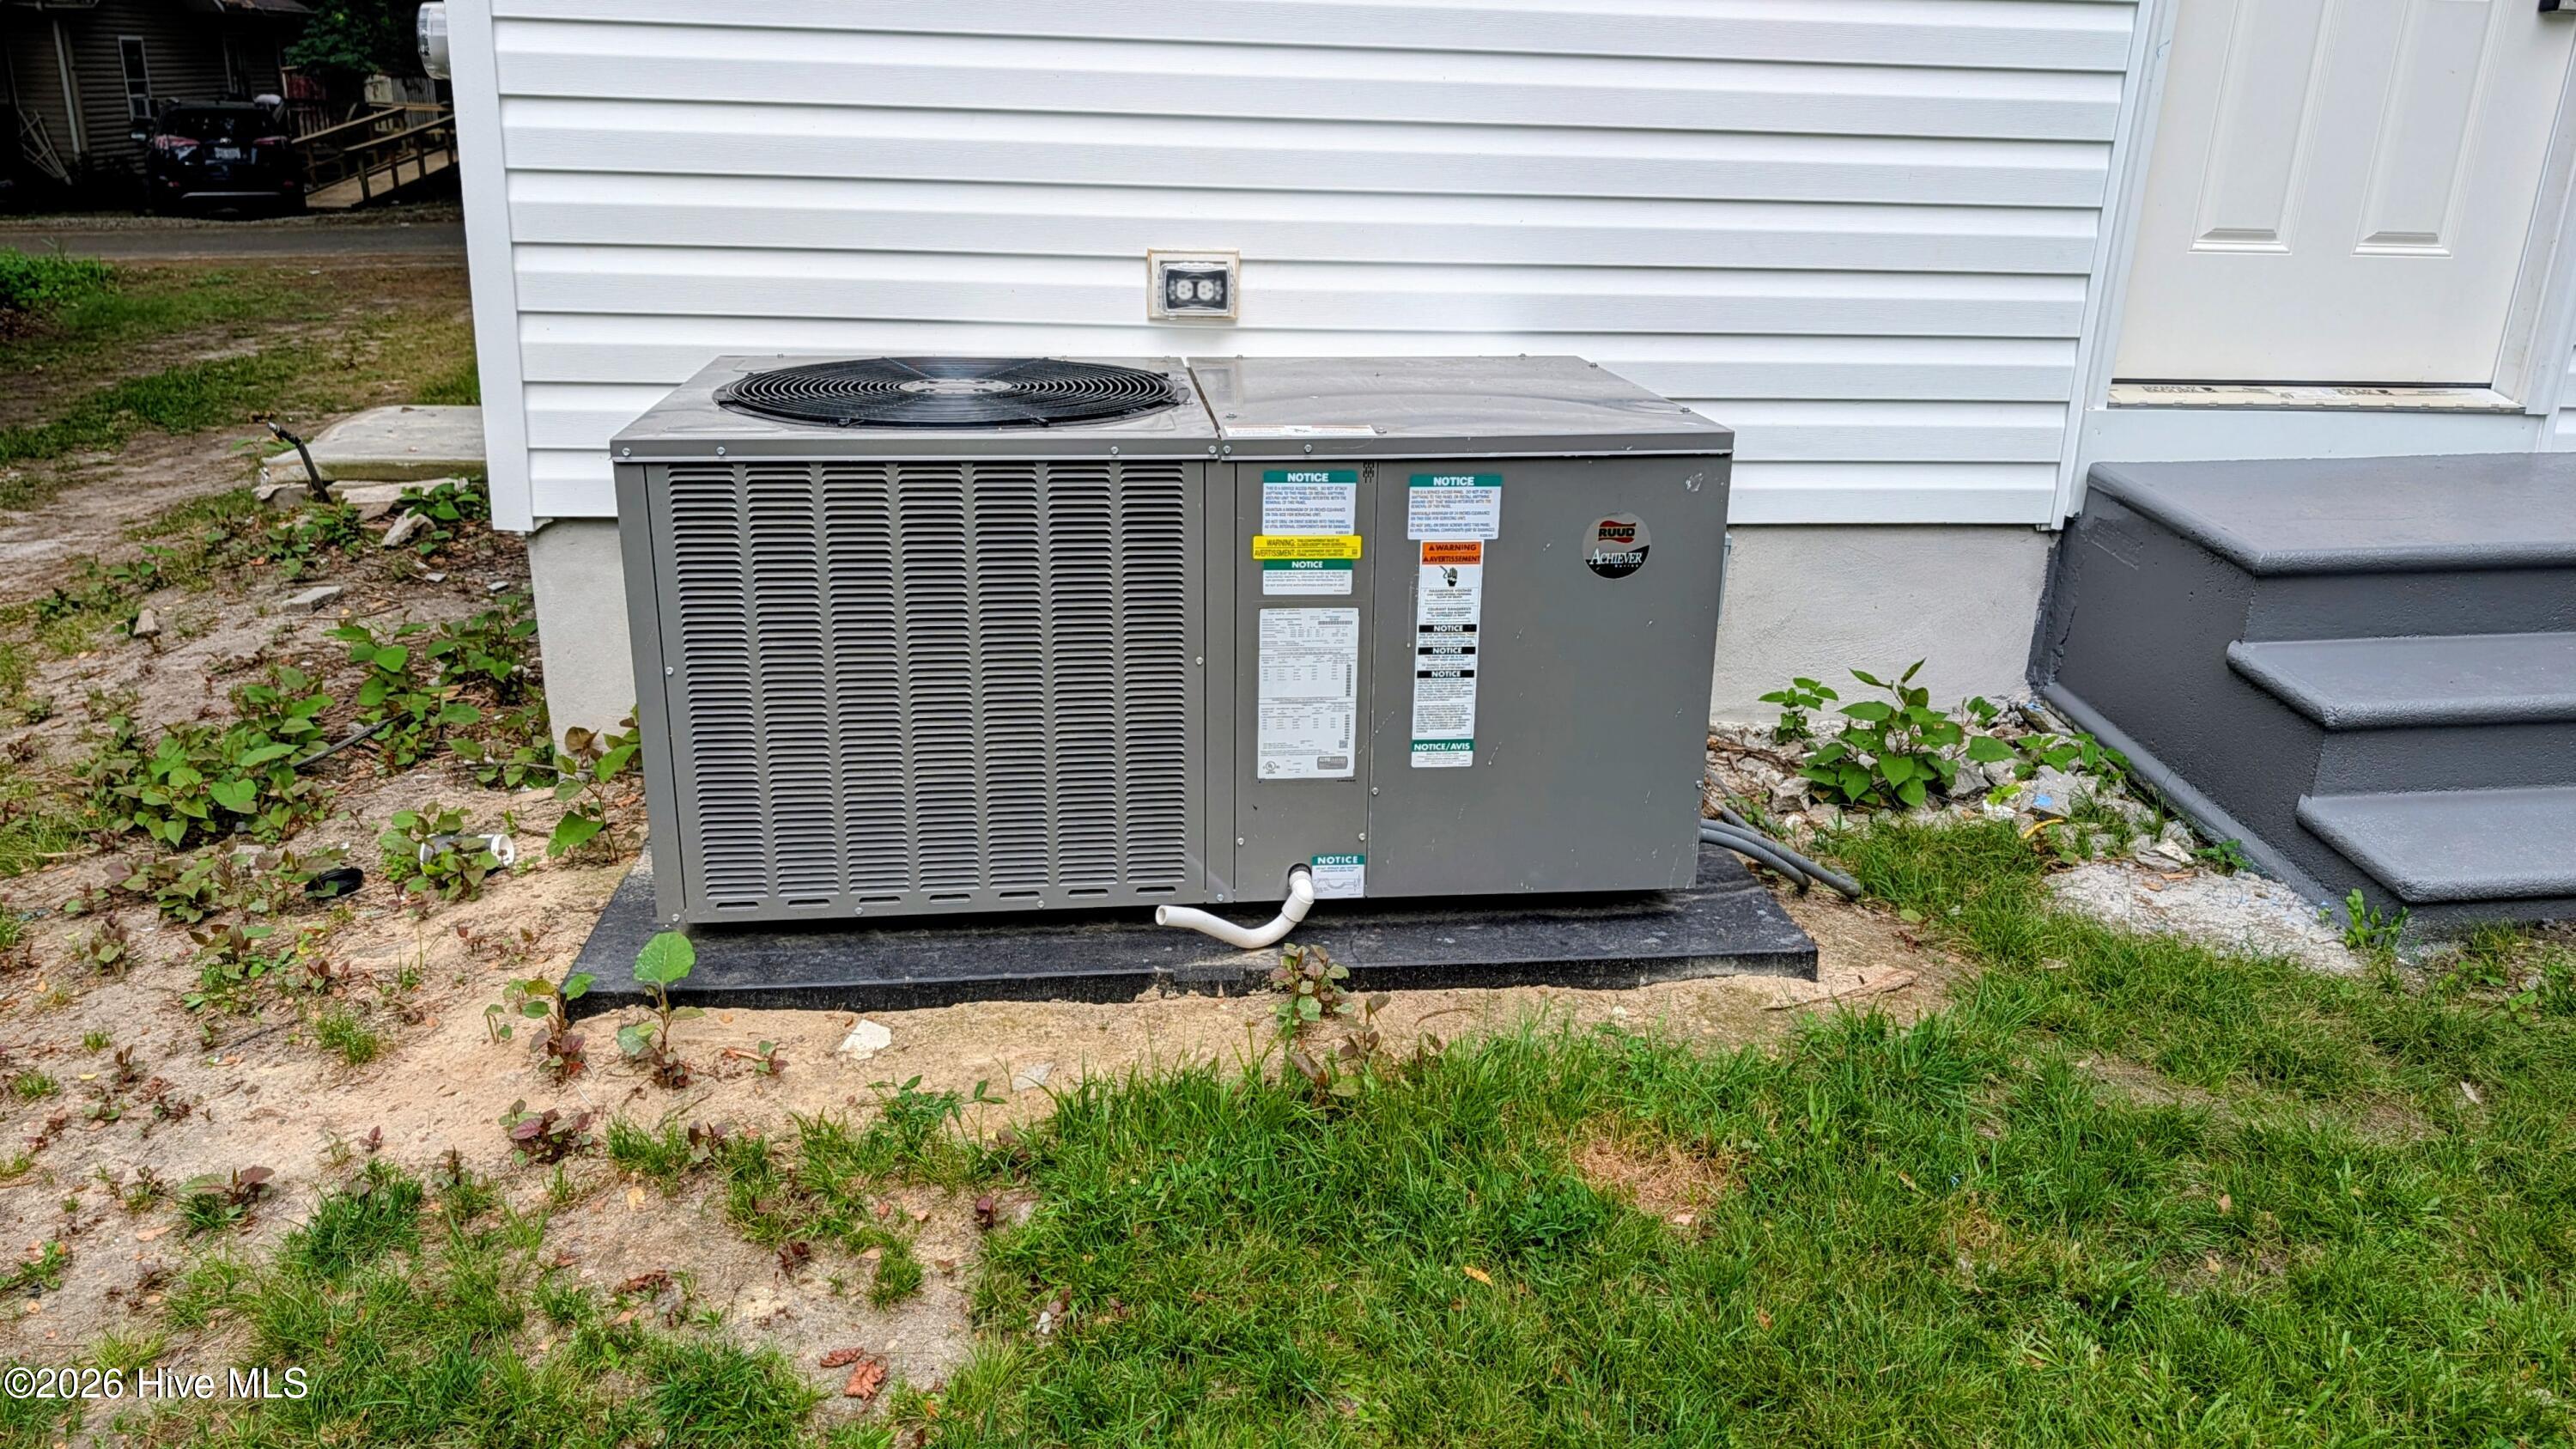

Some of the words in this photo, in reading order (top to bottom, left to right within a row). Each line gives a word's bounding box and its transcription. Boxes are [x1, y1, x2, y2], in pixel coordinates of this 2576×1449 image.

[1287, 473, 1329, 482] NOTICE
[1433, 477, 1474, 485] NOTICE
[1598, 528, 1635, 537] RUUD
[1589, 548, 1643, 564] ACHIEVER
[1317, 856, 1358, 864] NOTICE
